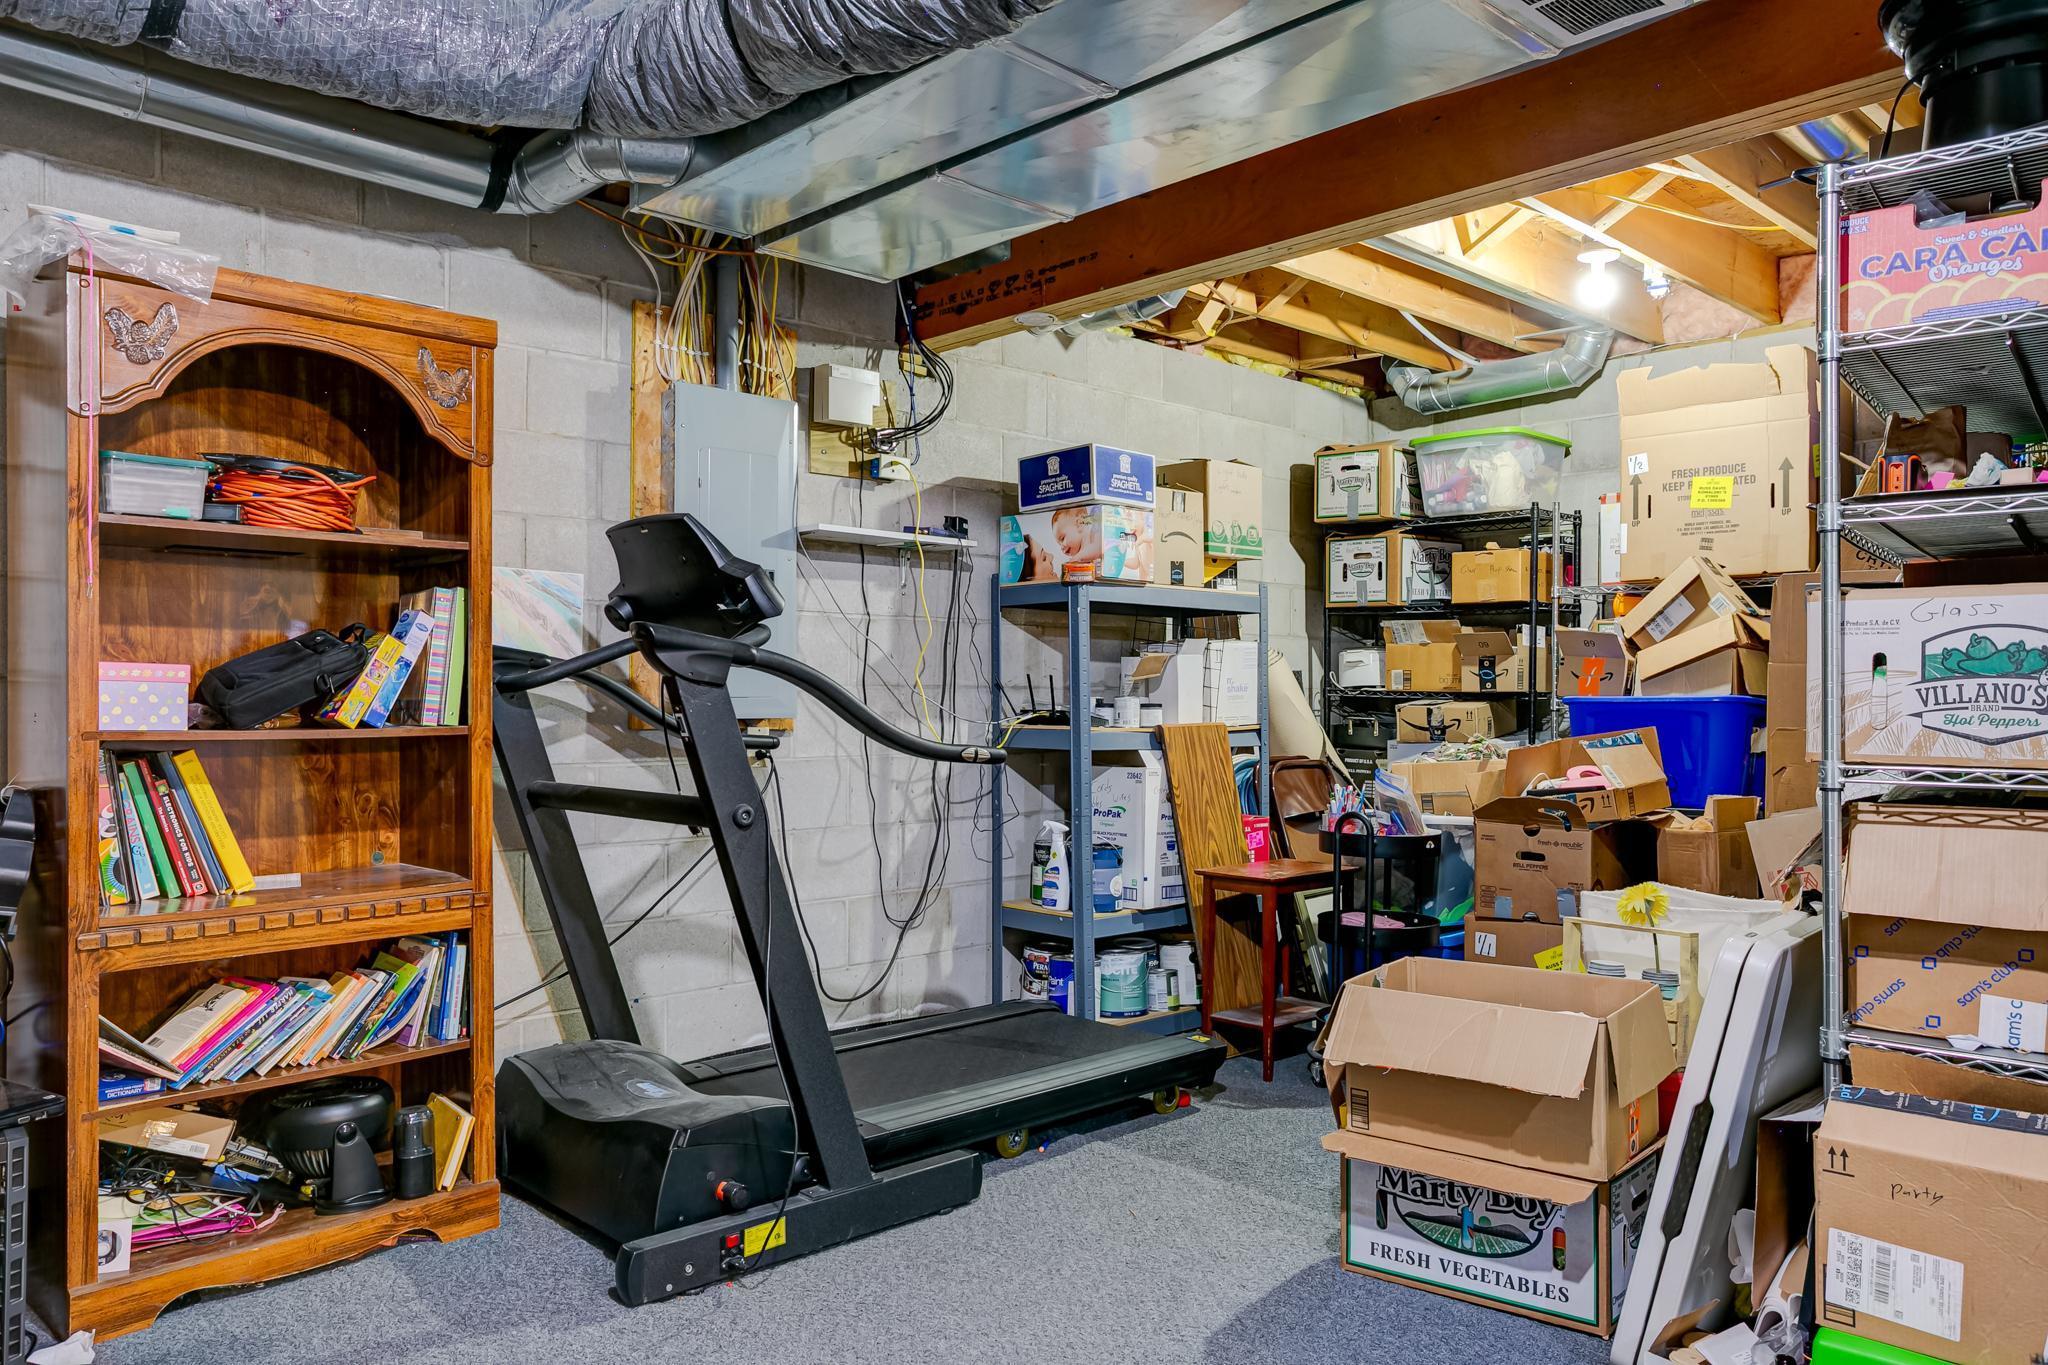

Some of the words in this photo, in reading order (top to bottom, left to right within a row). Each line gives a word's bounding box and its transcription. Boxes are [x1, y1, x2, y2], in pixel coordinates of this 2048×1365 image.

[1840, 217, 1869, 228] RODUCE
[1934, 234, 1966, 245] Sweet
[1968, 230, 1978, 240] &
[1980, 224, 2026, 239] Seedless
[1860, 242, 1969, 279] CARA
[1928, 256, 2024, 282] Oranges
[1671, 468, 1700, 479] FRESH
[1702, 463, 1746, 476] PRODUCE
[1662, 481, 1685, 492] KEEP
[1439, 549, 1451, 560] Bo
[1916, 681, 2047, 708] VILLANO'S
[1970, 703, 2000, 712] BRAND
[1943, 714, 1974, 725] Hot
[1977, 714, 2041, 729] Peppers
[1127, 772, 1142, 780] 23642
[163, 796, 183, 838] ELECTRONICS
[1093, 808, 1121, 818] ProPak
[180, 838, 189, 851] FOR
[184, 851, 193, 867] KIDS
[1873, 978, 1906, 1005] sam's
[1957, 978, 1992, 1007] sam's
[1991, 960, 2020, 984] club
[107, 1087, 142, 1099] DICTIONARY
[1840, 1084, 1852, 1099] pri
[1970, 1105, 1986, 1122] pri
[1377, 1166, 1484, 1210] Marty
[1369, 1241, 1431, 1270] FRESH
[1439, 1258, 1570, 1303] VEGETABLES
